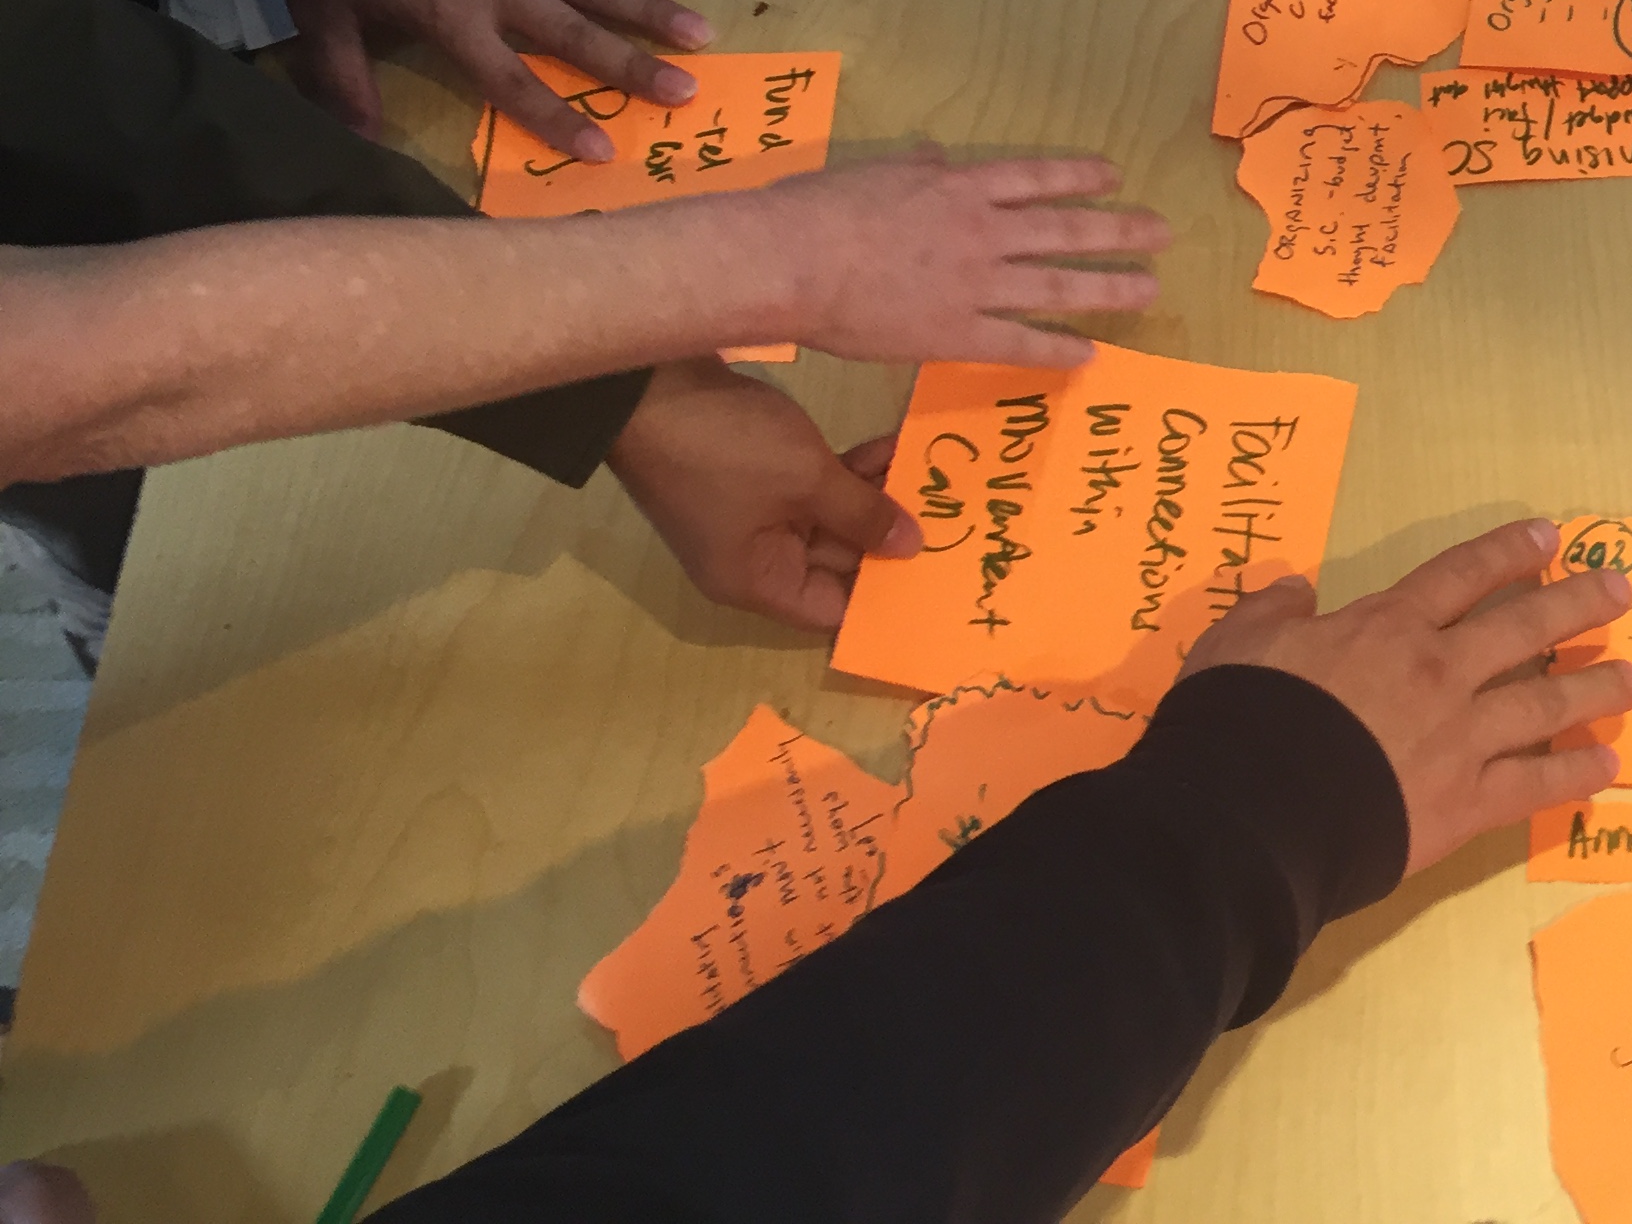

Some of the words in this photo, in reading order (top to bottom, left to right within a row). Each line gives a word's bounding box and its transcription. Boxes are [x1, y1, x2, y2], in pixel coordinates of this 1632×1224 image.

[759, 68, 816, 152] Fund
[1442, 140, 1496, 176] SC
[1131, 408, 1208, 631] Connections
